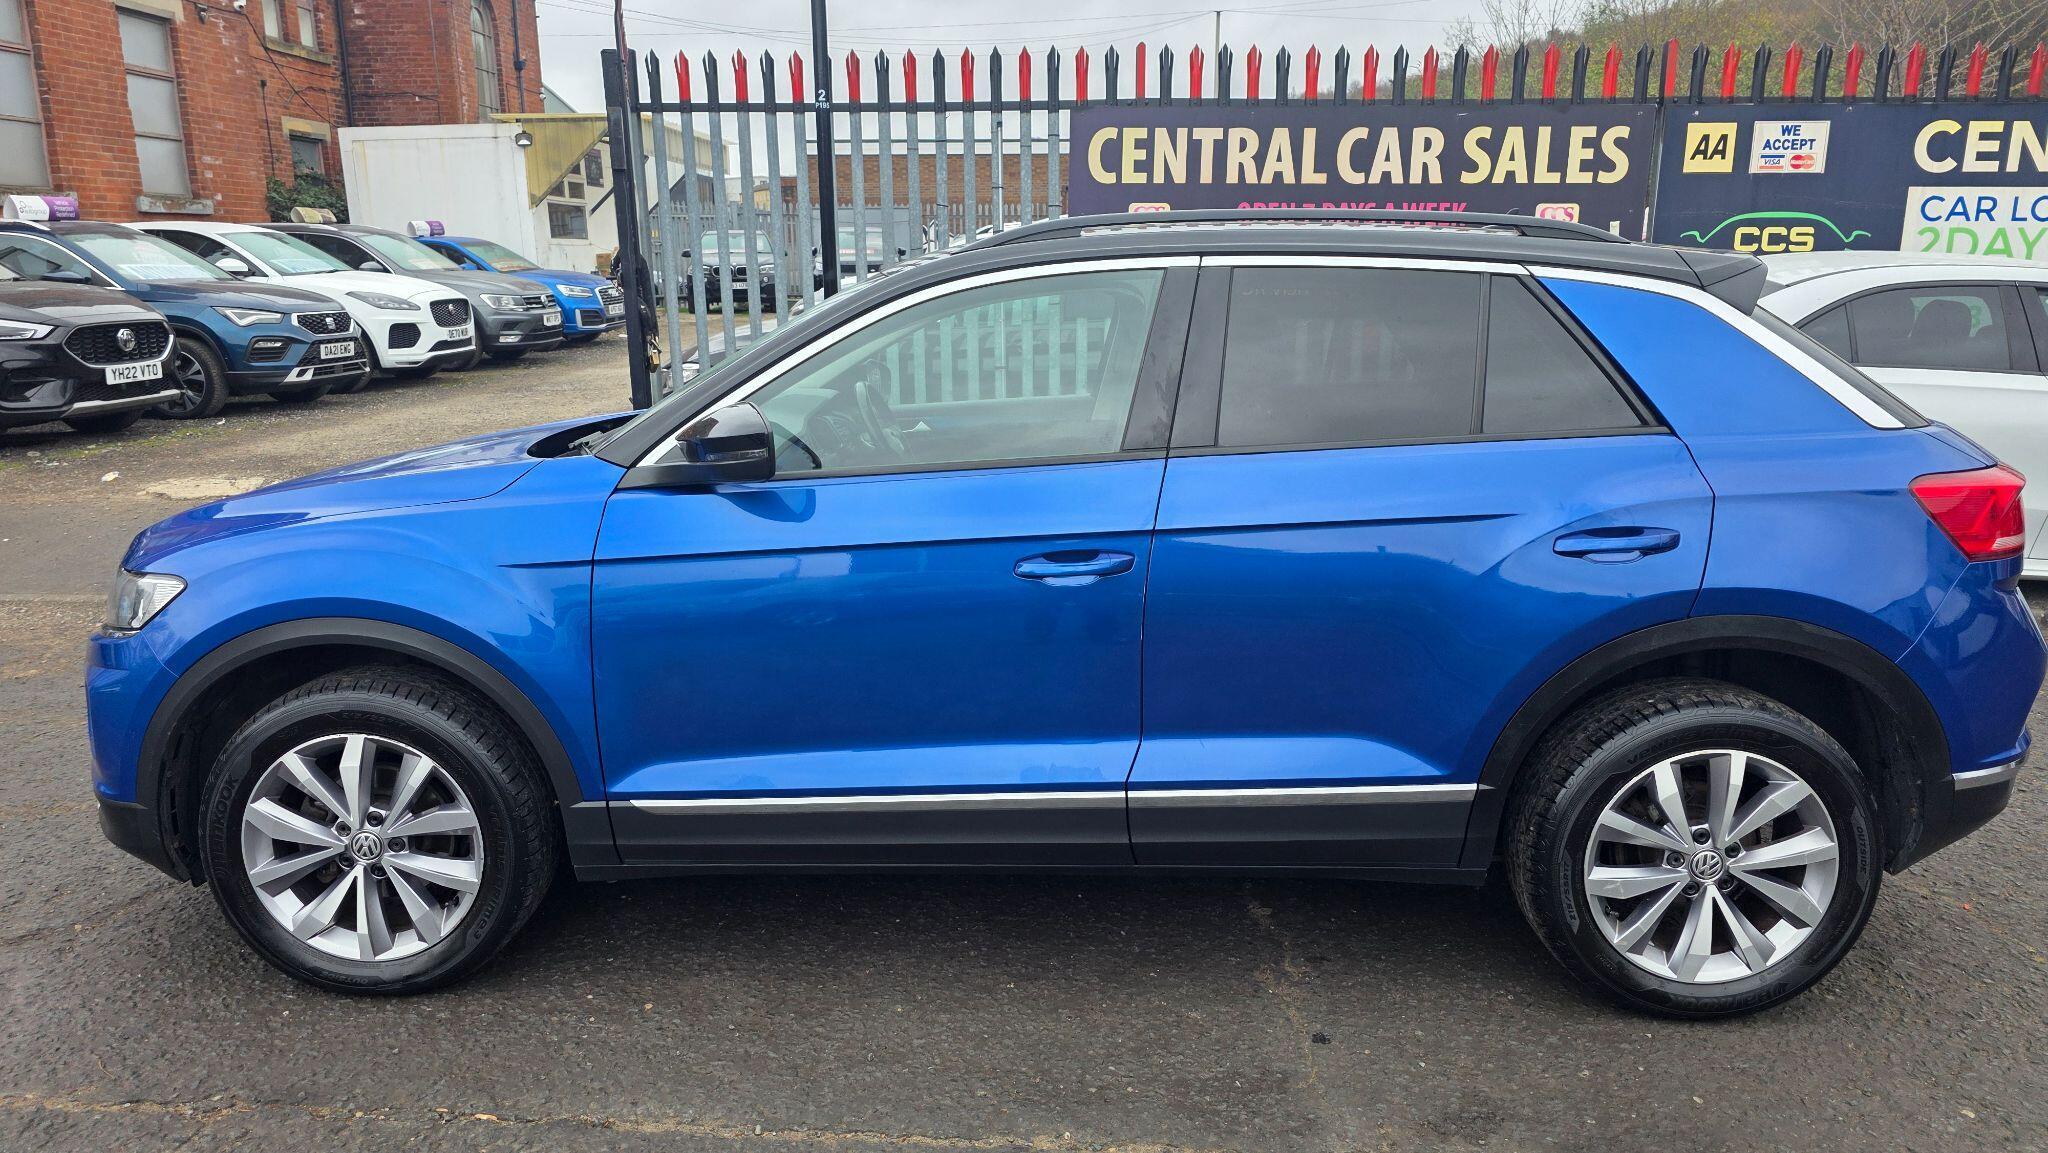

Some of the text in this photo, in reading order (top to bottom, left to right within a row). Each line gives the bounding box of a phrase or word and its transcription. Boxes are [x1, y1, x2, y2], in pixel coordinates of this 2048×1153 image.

[817, 89, 826, 101] 2
[1780, 124, 1802, 137] WE
[1087, 125, 1631, 185] CENTRAL CAR SALES
[1689, 133, 1729, 161] AA
[1762, 138, 1816, 151] ACCEPT
[1913, 119, 2048, 173] CEN
[1764, 158, 1782, 166] VISA
[1920, 195, 1998, 222] CAR
[1733, 226, 1815, 252] CCS
[1917, 226, 2048, 260] 2DAY
[324, 344, 338, 356] DA21
[111, 364, 158, 381] YH22 VTO
